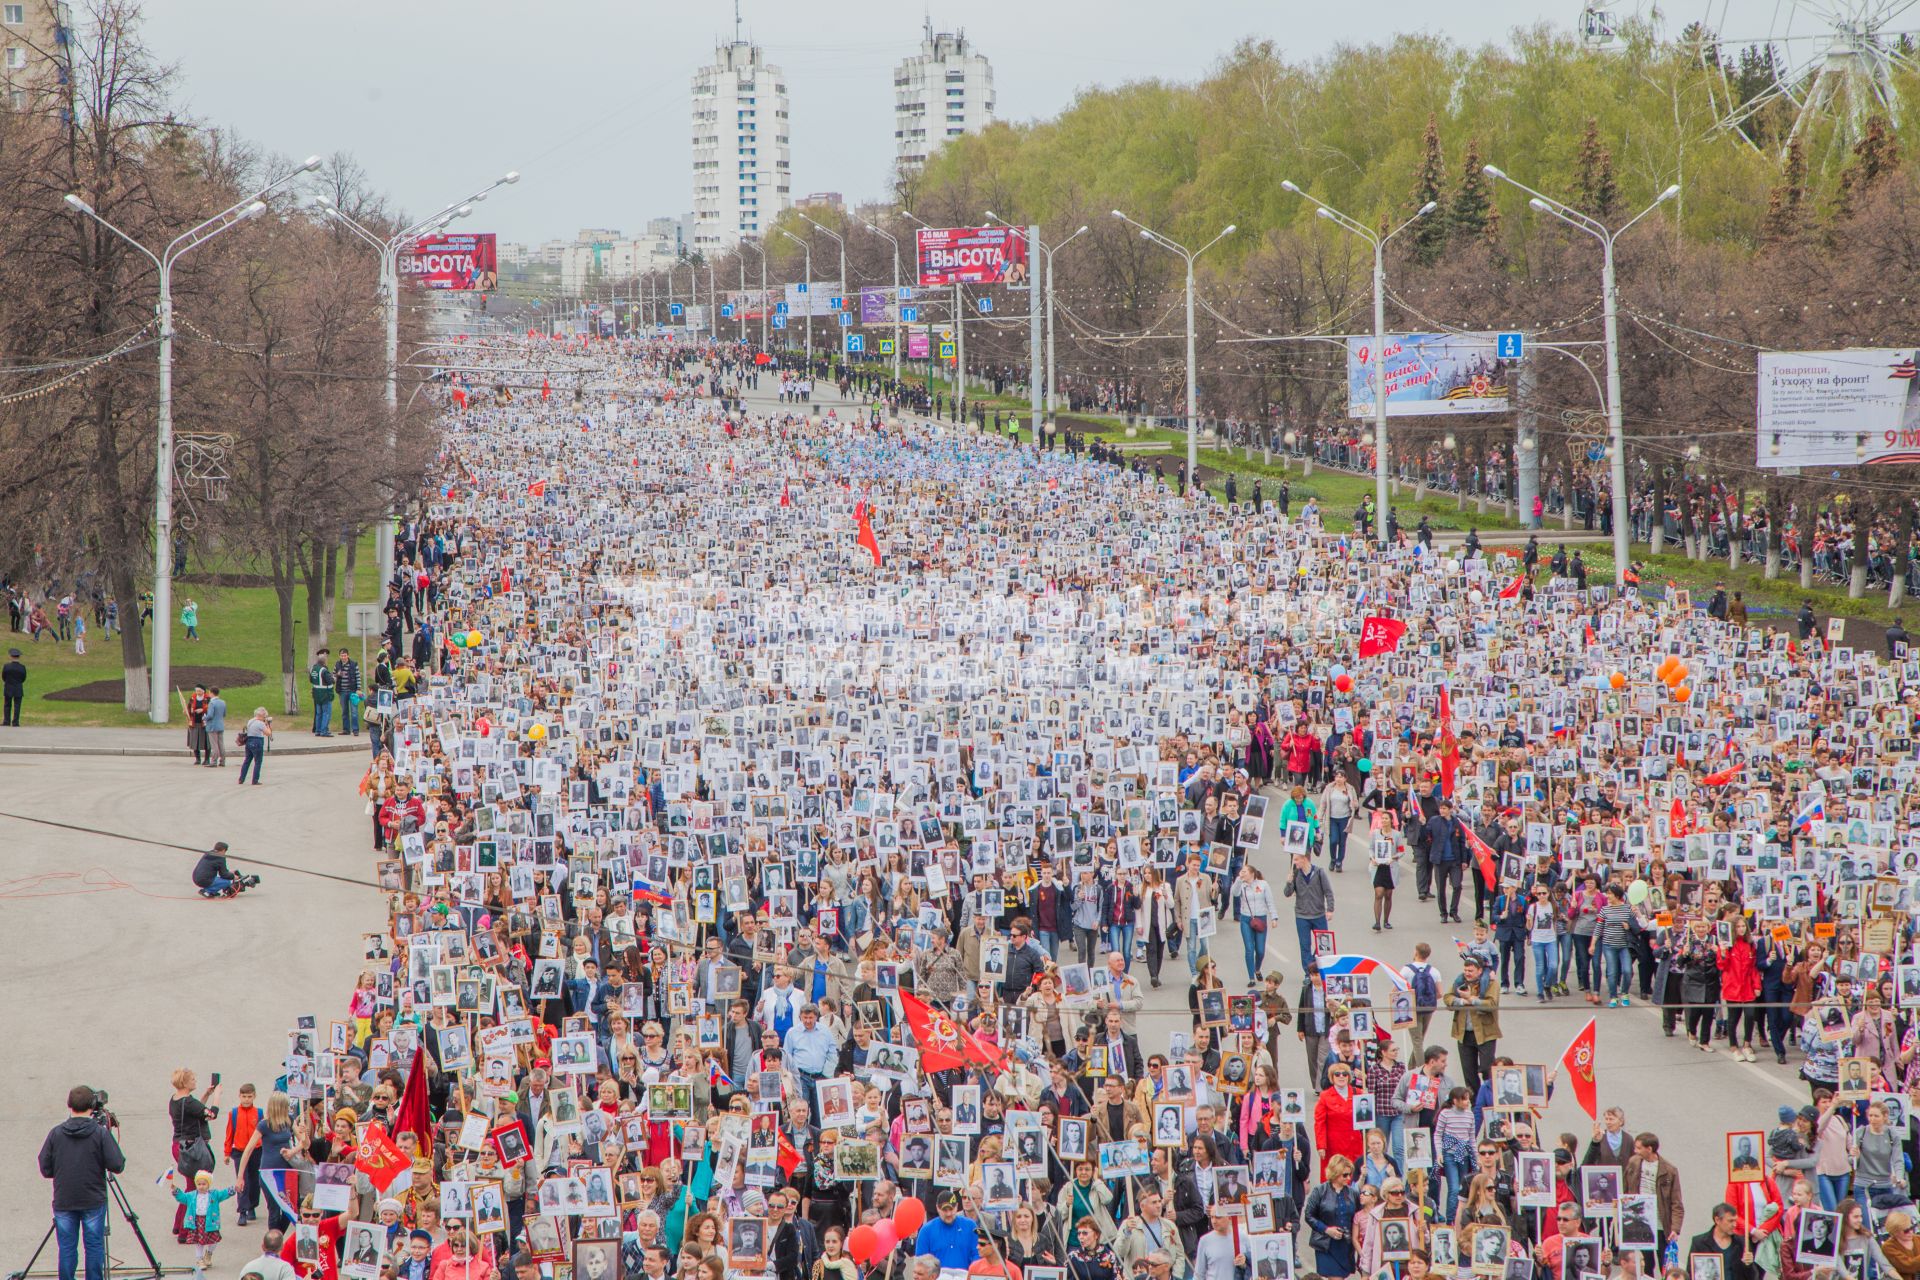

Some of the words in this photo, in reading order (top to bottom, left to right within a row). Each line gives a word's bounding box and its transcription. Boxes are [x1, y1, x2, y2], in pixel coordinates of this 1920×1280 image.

[923, 231, 932, 239] 26
[933, 231, 948, 239] МАЯ
[398, 255, 475, 273] ВЫСОТА
[931, 248, 1004, 267] ВЫСОТА
[1358, 346, 1369, 364] 9
[1372, 343, 1402, 362] ая
[1367, 359, 1421, 386] Сасибо
[1402, 367, 1438, 387] мир!
[1772, 366, 1831, 376] Товарищи,
[1772, 377, 1778, 386] я
[1781, 376, 1814, 388] ухожу
[1817, 377, 1830, 385] на
[1832, 374, 1870, 387] фронт!
[1884, 429, 1897, 448] 9
